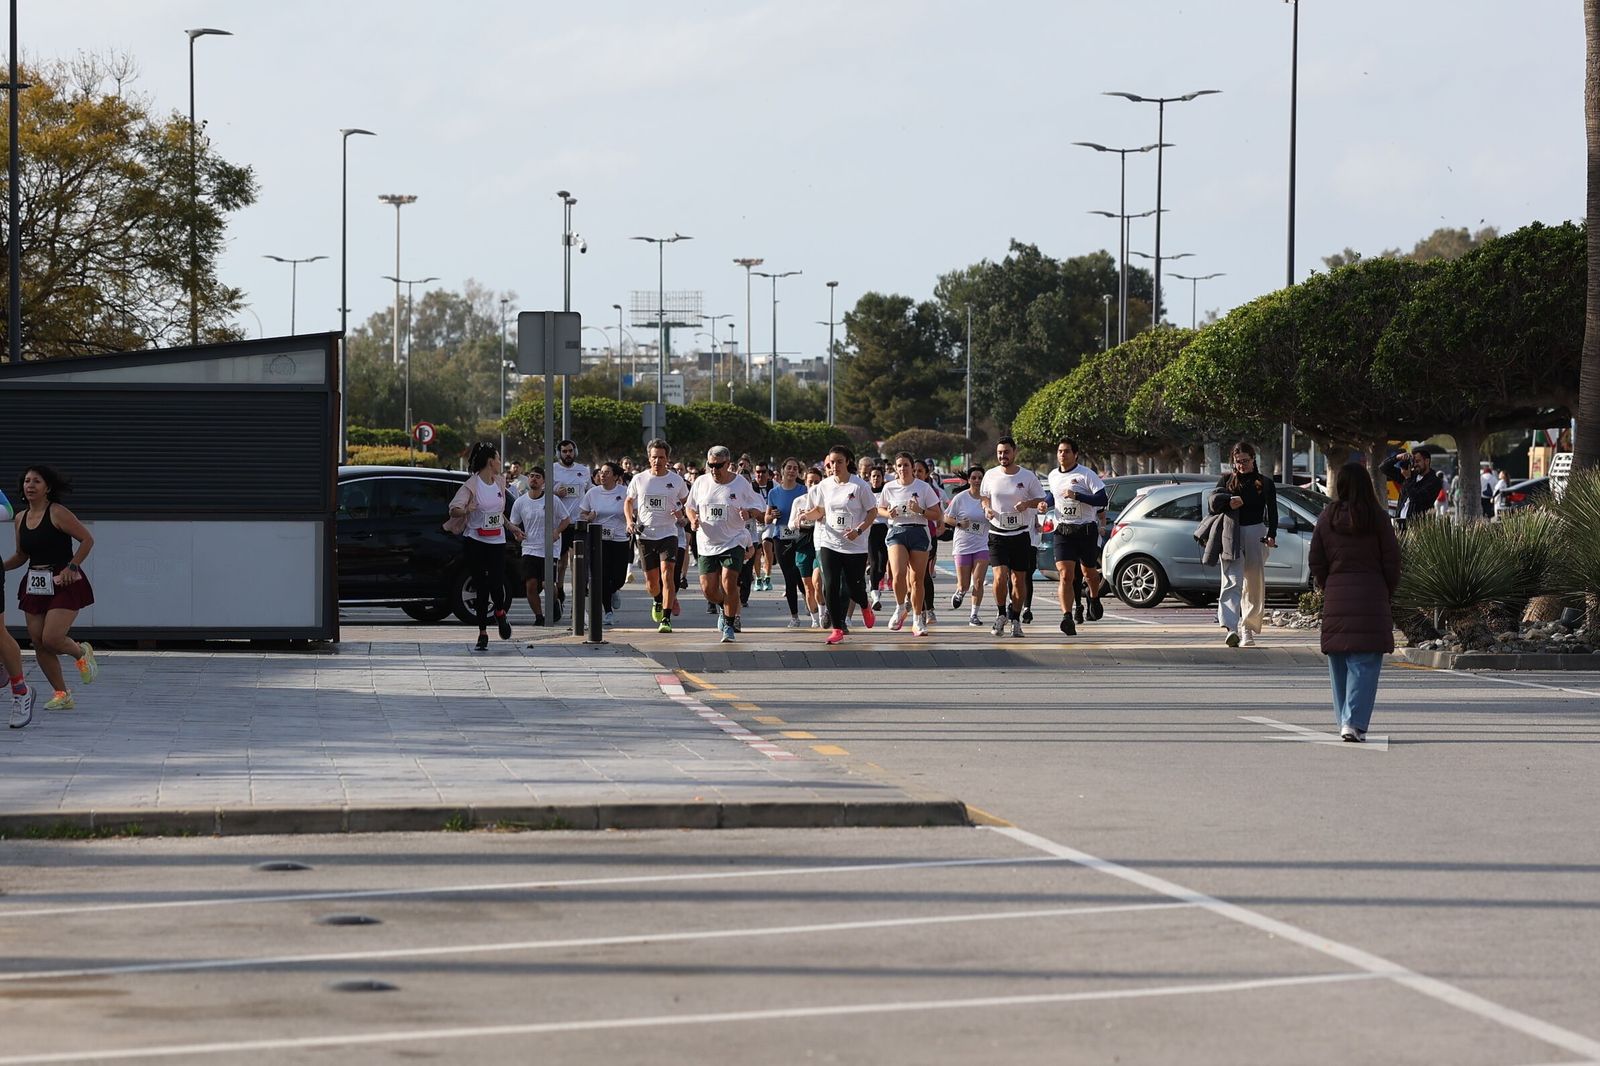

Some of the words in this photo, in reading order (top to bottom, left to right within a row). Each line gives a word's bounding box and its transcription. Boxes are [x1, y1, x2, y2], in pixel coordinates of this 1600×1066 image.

[649, 498, 662, 506] 501
[710, 508, 723, 516] 100
[1063, 507, 1077, 515] 237
[836, 516, 845, 525] 81
[1007, 516, 1018, 524] 181
[31, 576, 46, 588] 238
